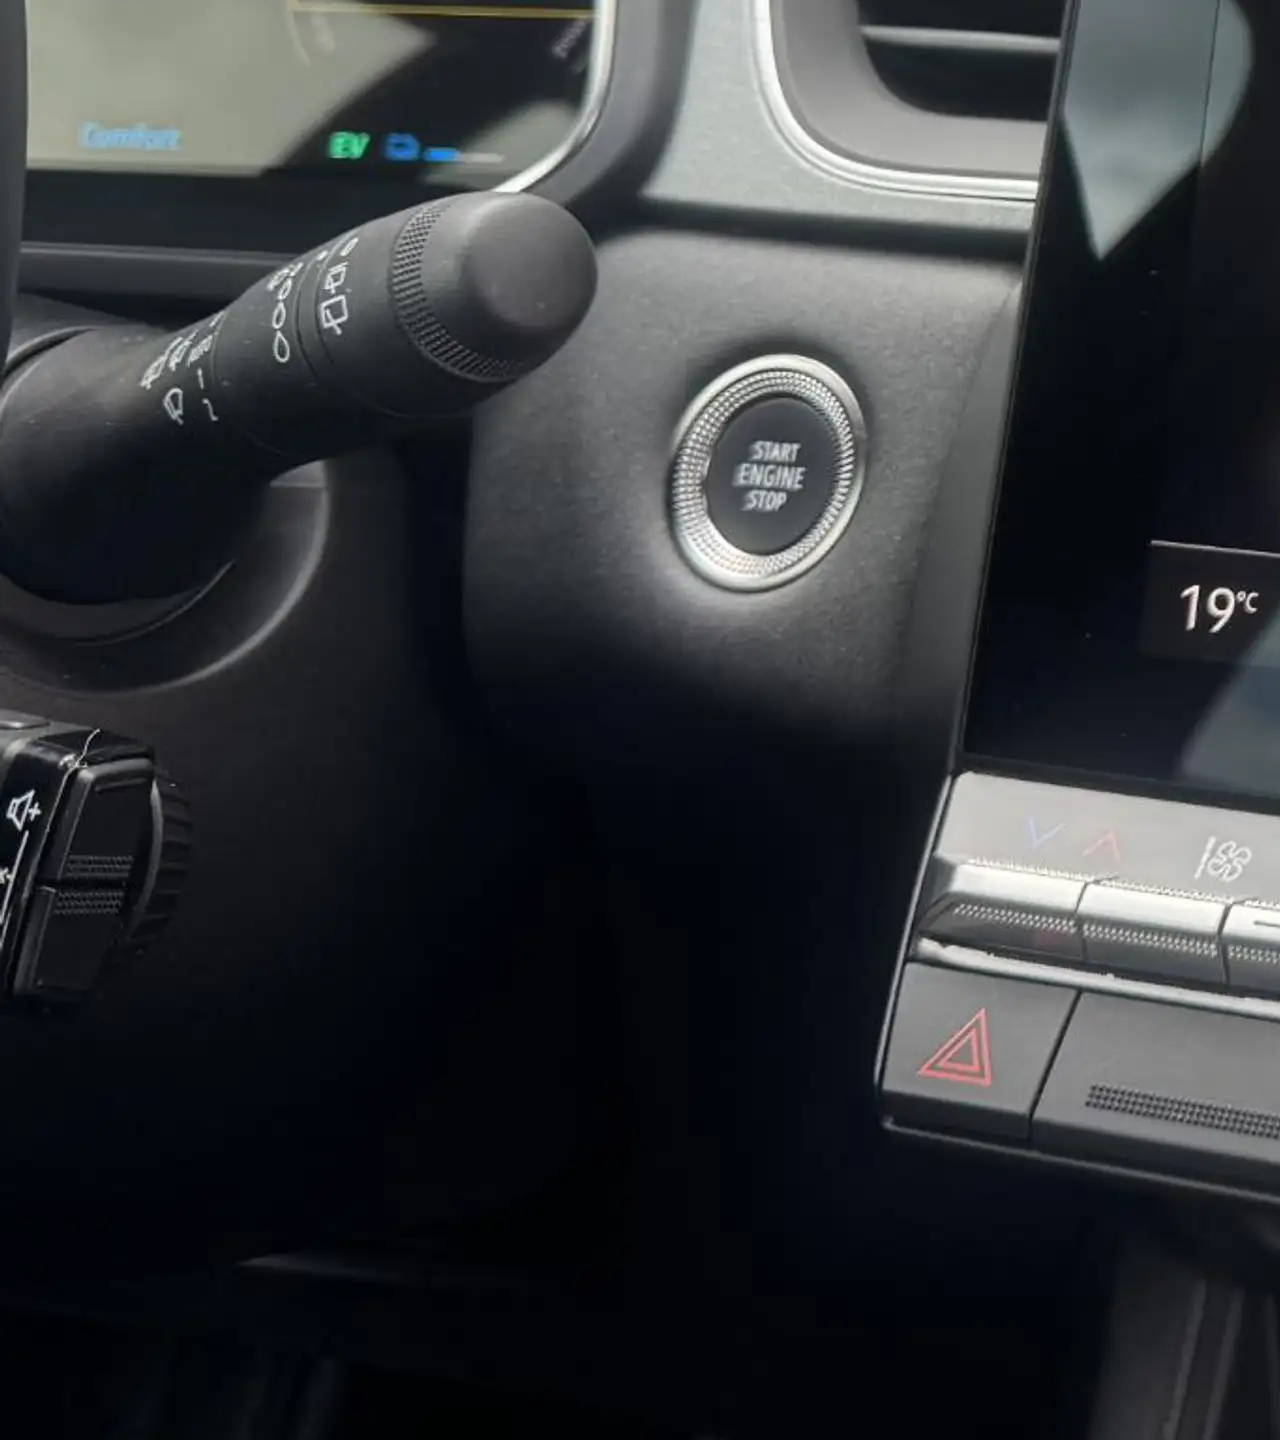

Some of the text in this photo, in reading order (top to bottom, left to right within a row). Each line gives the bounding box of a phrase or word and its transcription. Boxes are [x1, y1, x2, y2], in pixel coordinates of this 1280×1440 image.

[79, 122, 182, 150] Comfort
[330, 132, 370, 159] EV
[753, 440, 802, 461] START
[734, 463, 807, 489] ENGINE
[744, 490, 788, 511] STOP
